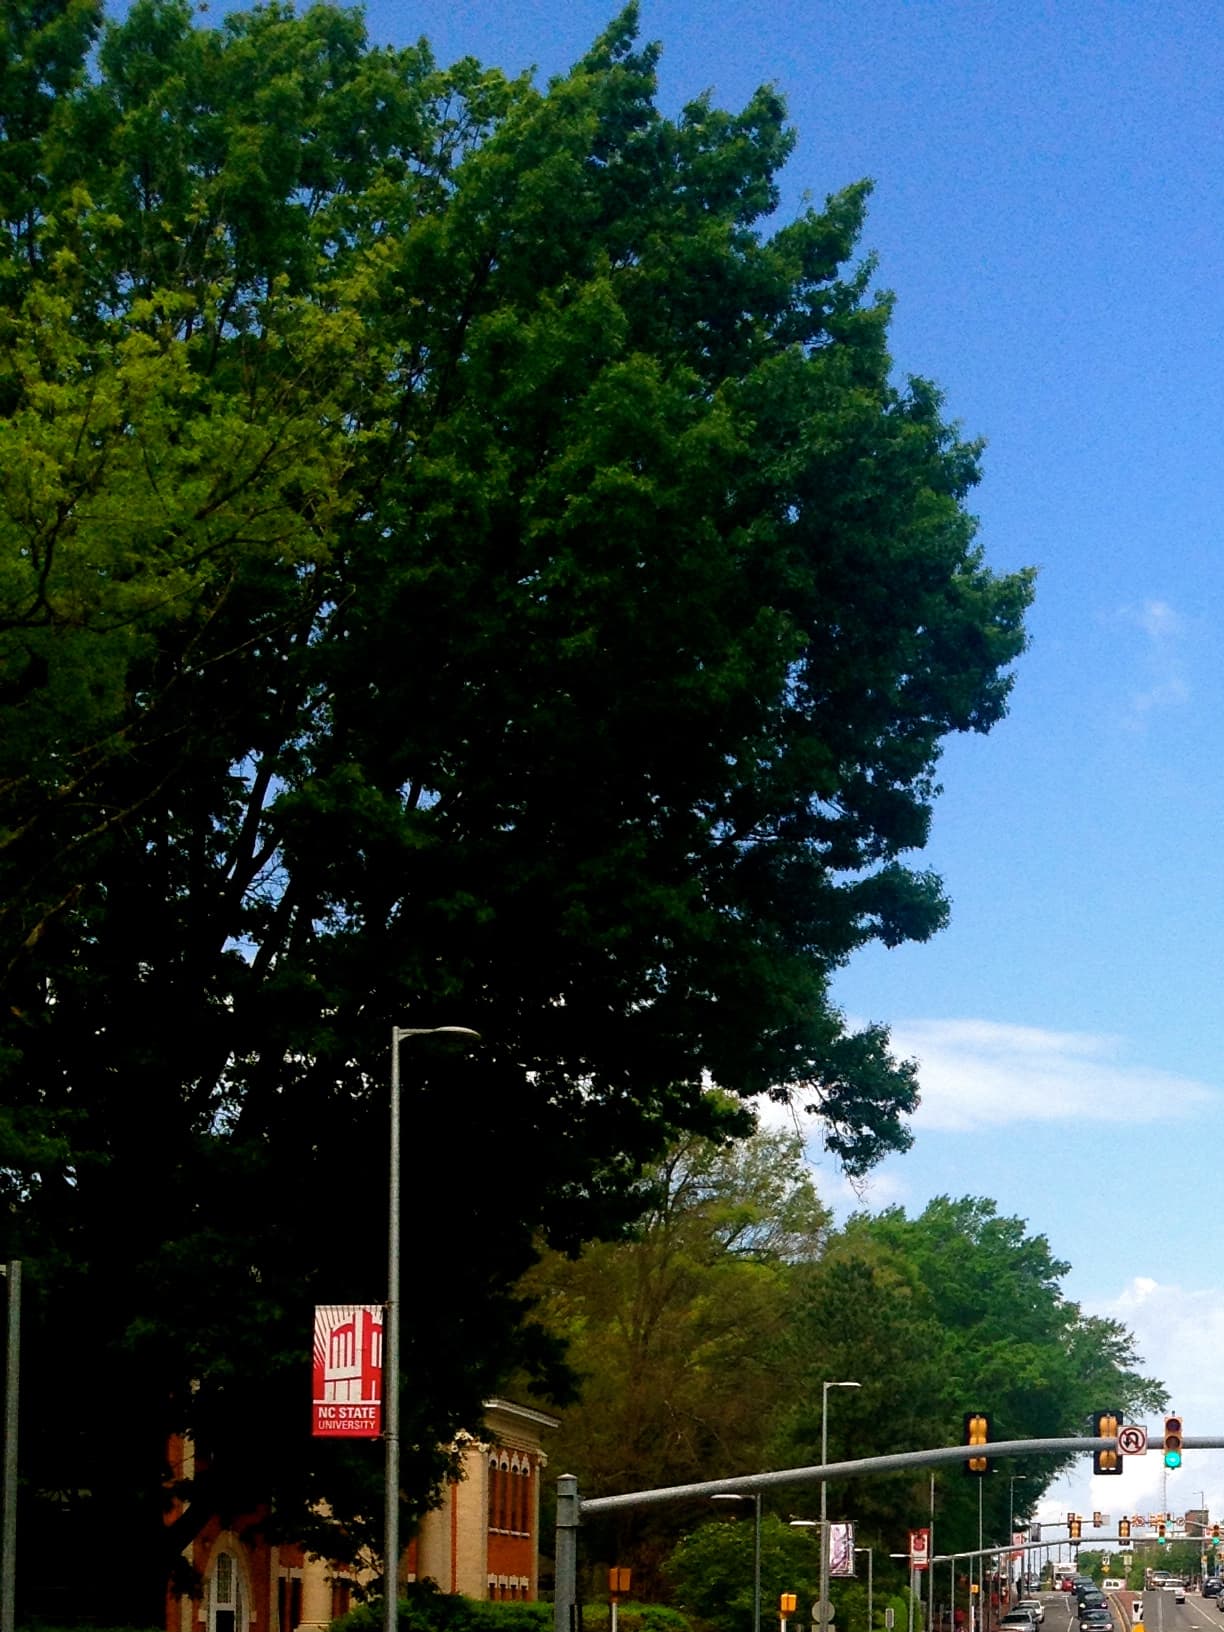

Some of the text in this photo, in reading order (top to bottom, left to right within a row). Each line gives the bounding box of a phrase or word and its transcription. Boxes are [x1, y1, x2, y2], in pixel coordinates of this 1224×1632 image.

[318, 1407, 376, 1419] NC STATE
[318, 1420, 376, 1430] UNIVERSITY
